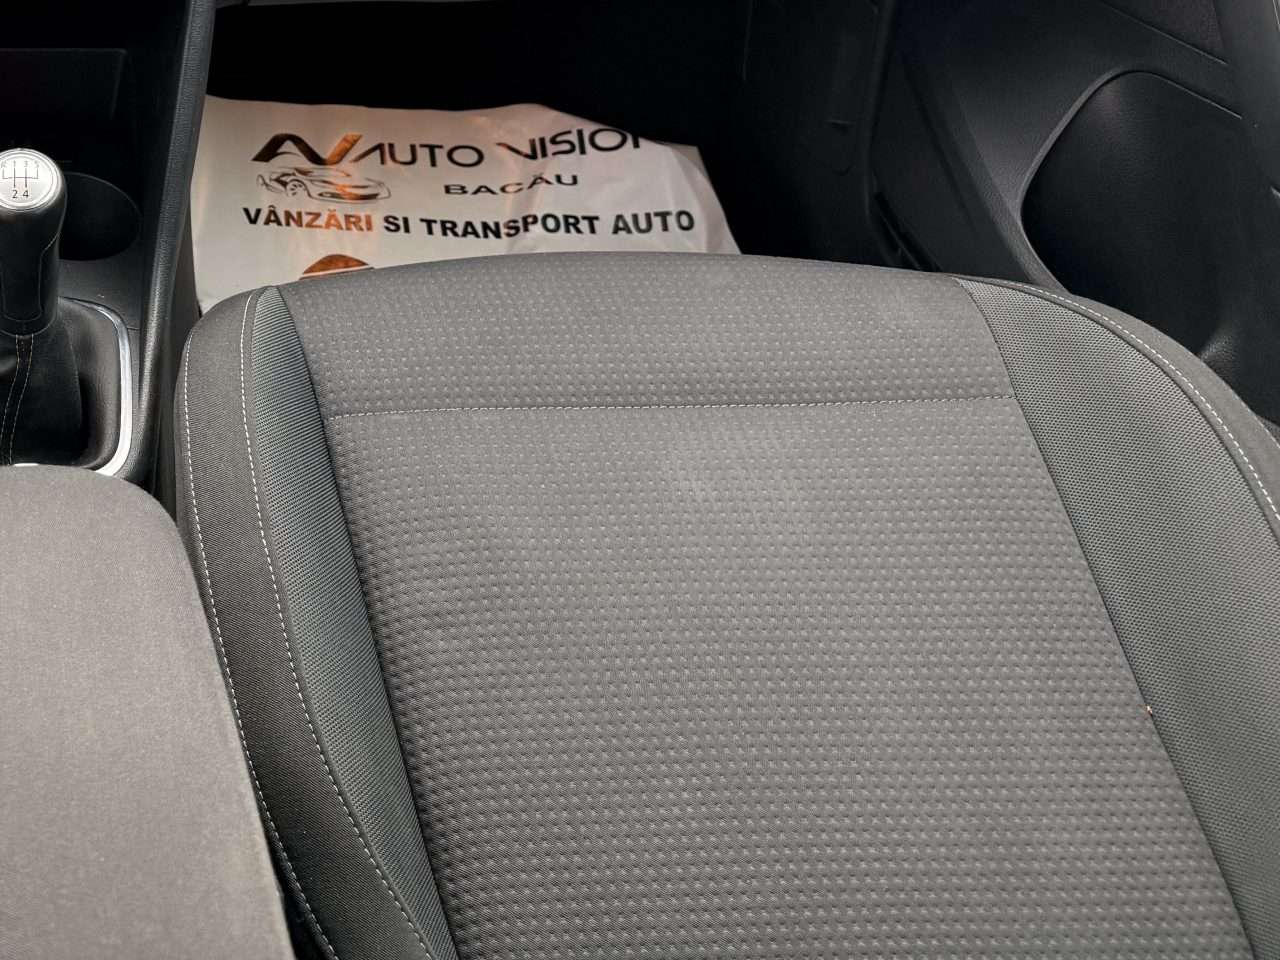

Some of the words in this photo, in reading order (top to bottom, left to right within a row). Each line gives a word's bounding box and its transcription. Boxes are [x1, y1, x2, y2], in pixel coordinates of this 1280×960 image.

[349, 142, 485, 168] AUTO
[12, 189, 18, 199] 2
[22, 189, 29, 198] 4
[443, 172, 579, 195] BACĂU
[242, 205, 374, 232] VÂNZĂRI
[383, 215, 411, 234] SI
[419, 213, 600, 239] TRANSPORT
[612, 210, 696, 235] AUTO
